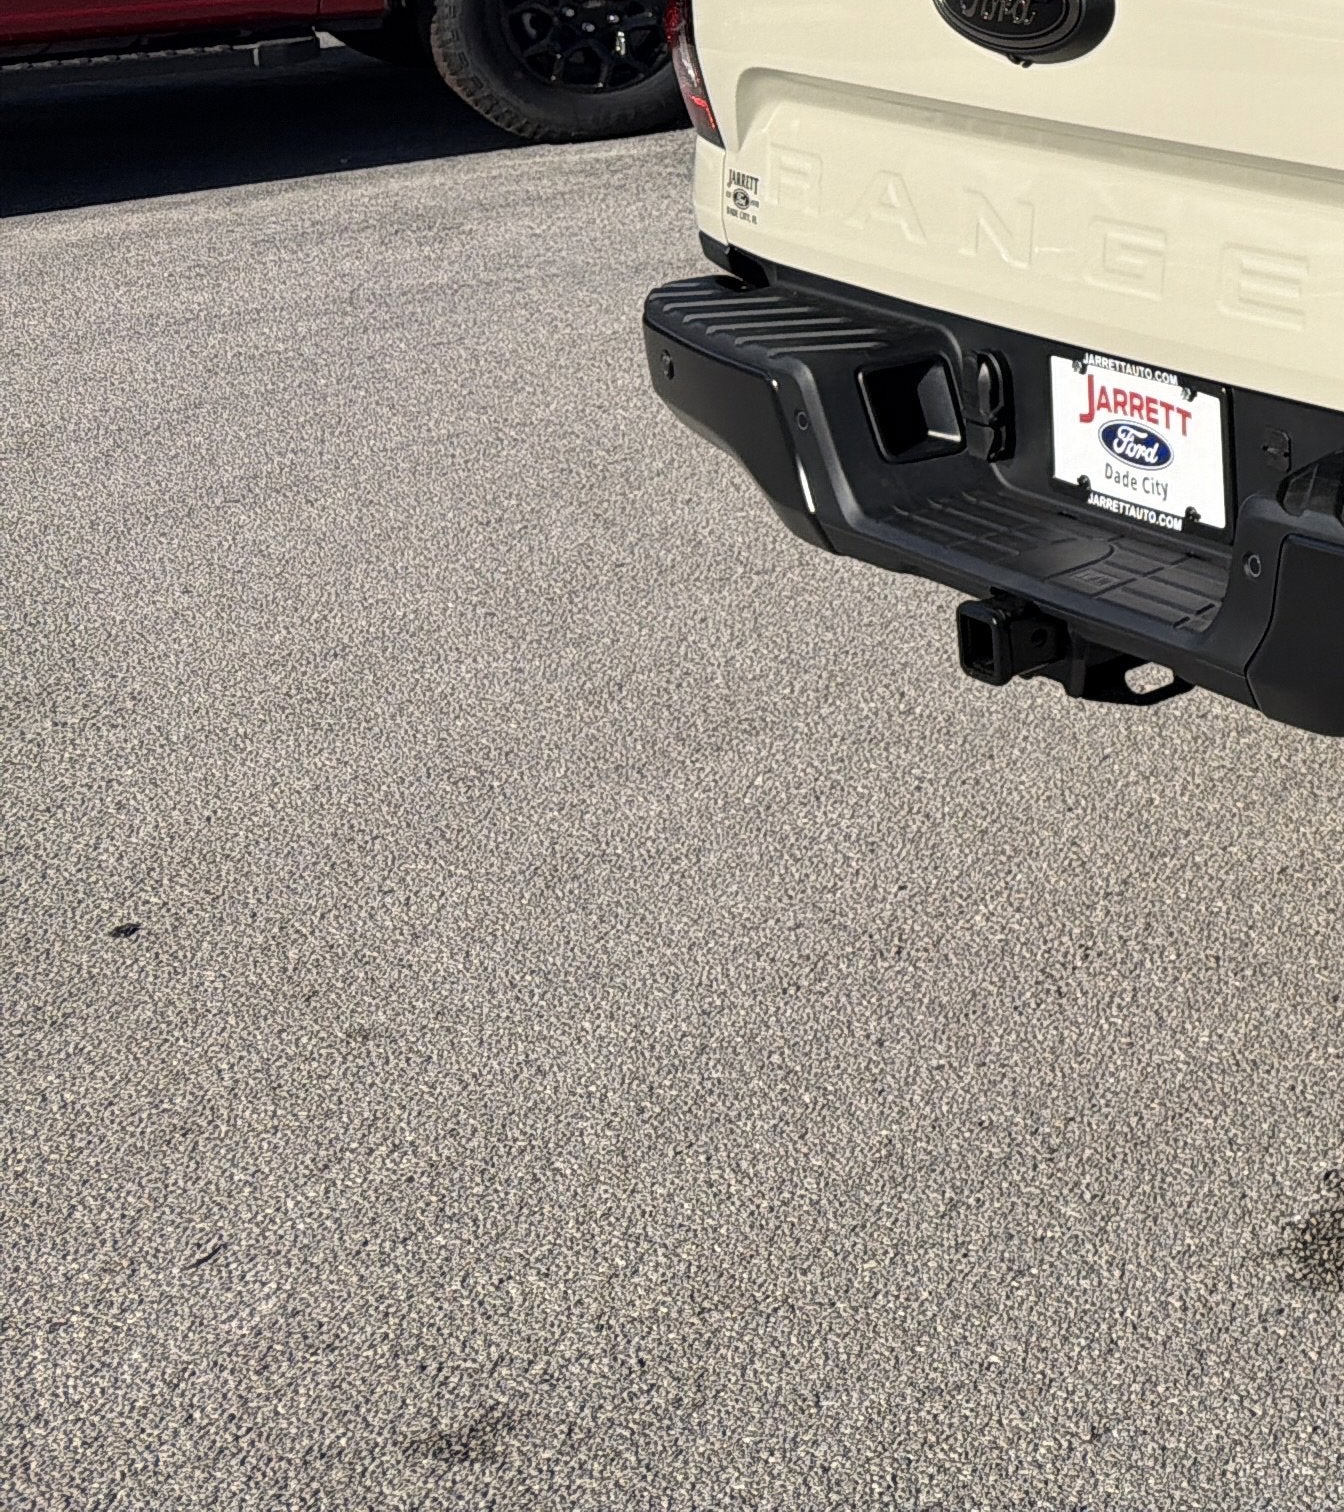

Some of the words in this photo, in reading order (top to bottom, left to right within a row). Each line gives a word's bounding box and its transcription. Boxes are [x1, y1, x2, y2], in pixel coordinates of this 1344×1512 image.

[1082, 352, 1179, 386] JARRETTAUTO.COM
[1079, 373, 1193, 437] JARRETT
[1112, 425, 1159, 464] Ford
[1104, 462, 1138, 492] Dade
[1142, 476, 1169, 502] City
[1087, 492, 1183, 532] JARRETTAUTO.COM
